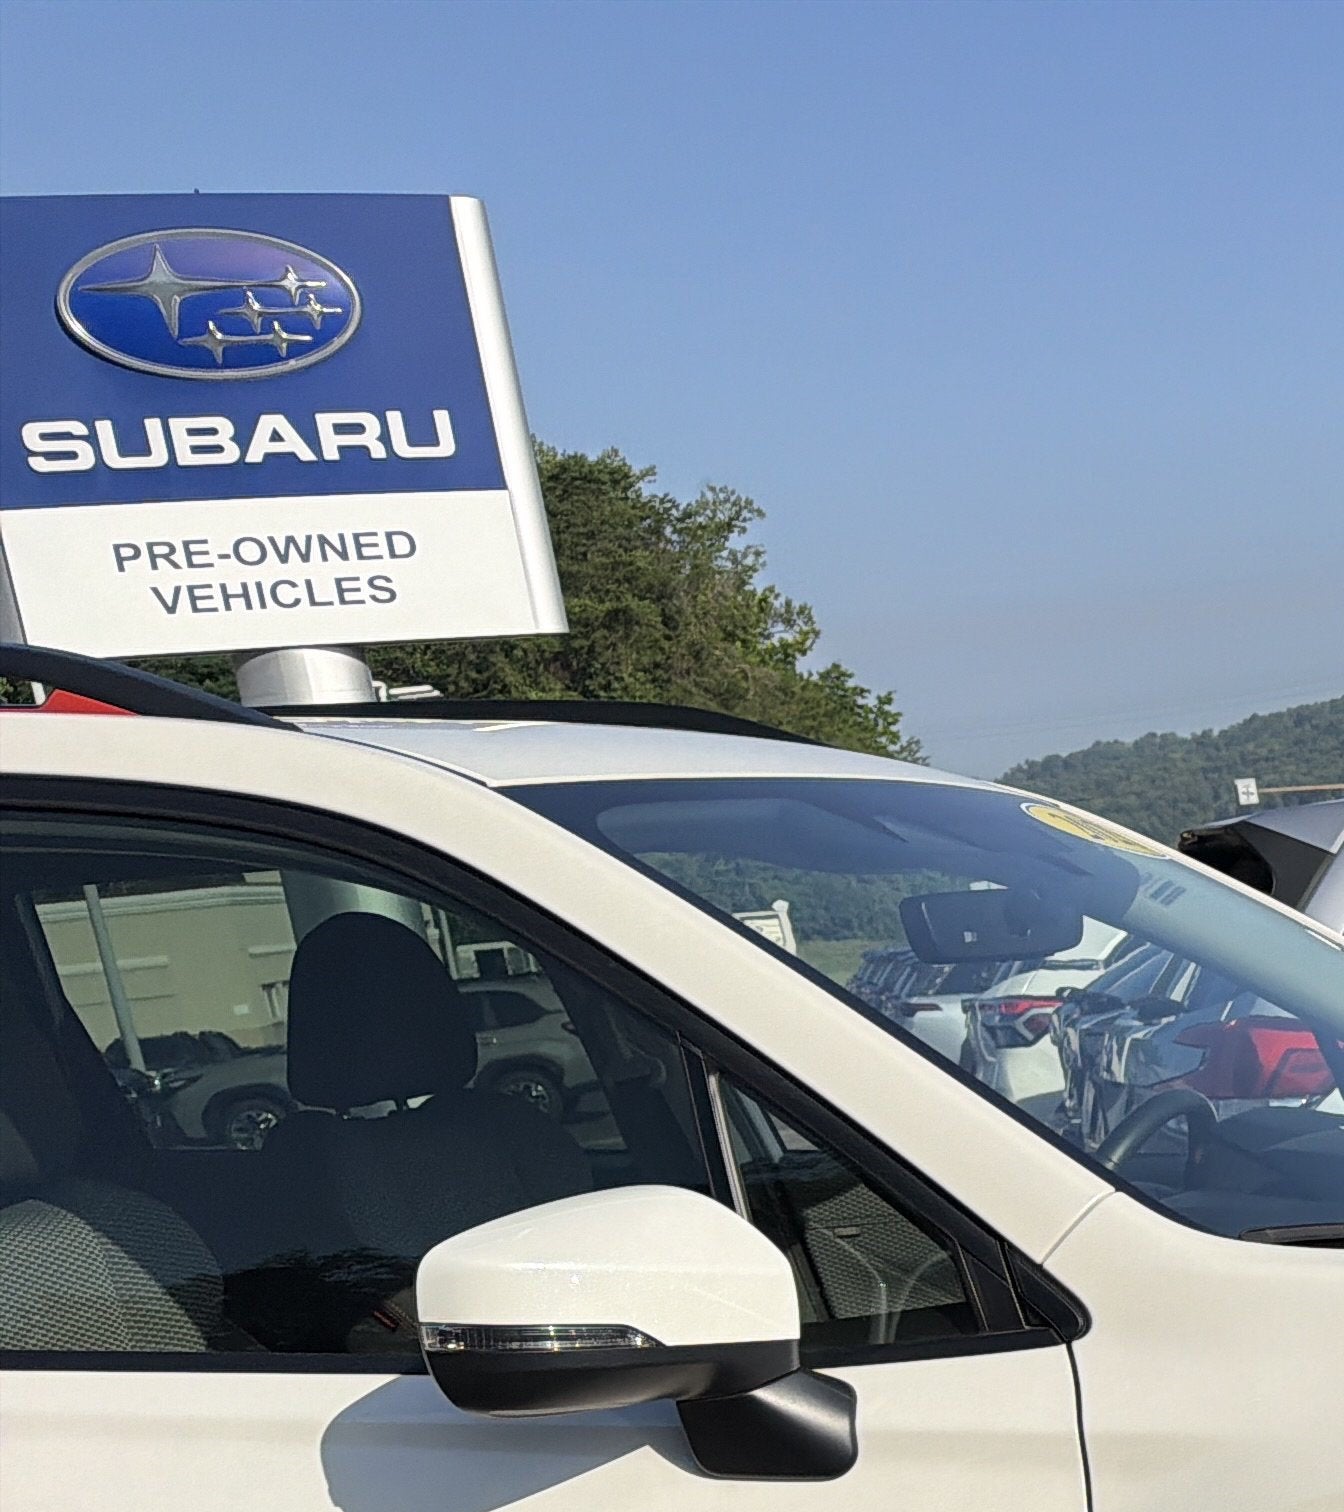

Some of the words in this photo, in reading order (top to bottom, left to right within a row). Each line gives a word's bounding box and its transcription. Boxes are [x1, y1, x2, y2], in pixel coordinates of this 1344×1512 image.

[21, 409, 457, 473] SUBARU
[112, 530, 418, 574] PRE-OWNED
[151, 576, 398, 616] VEHICLES
